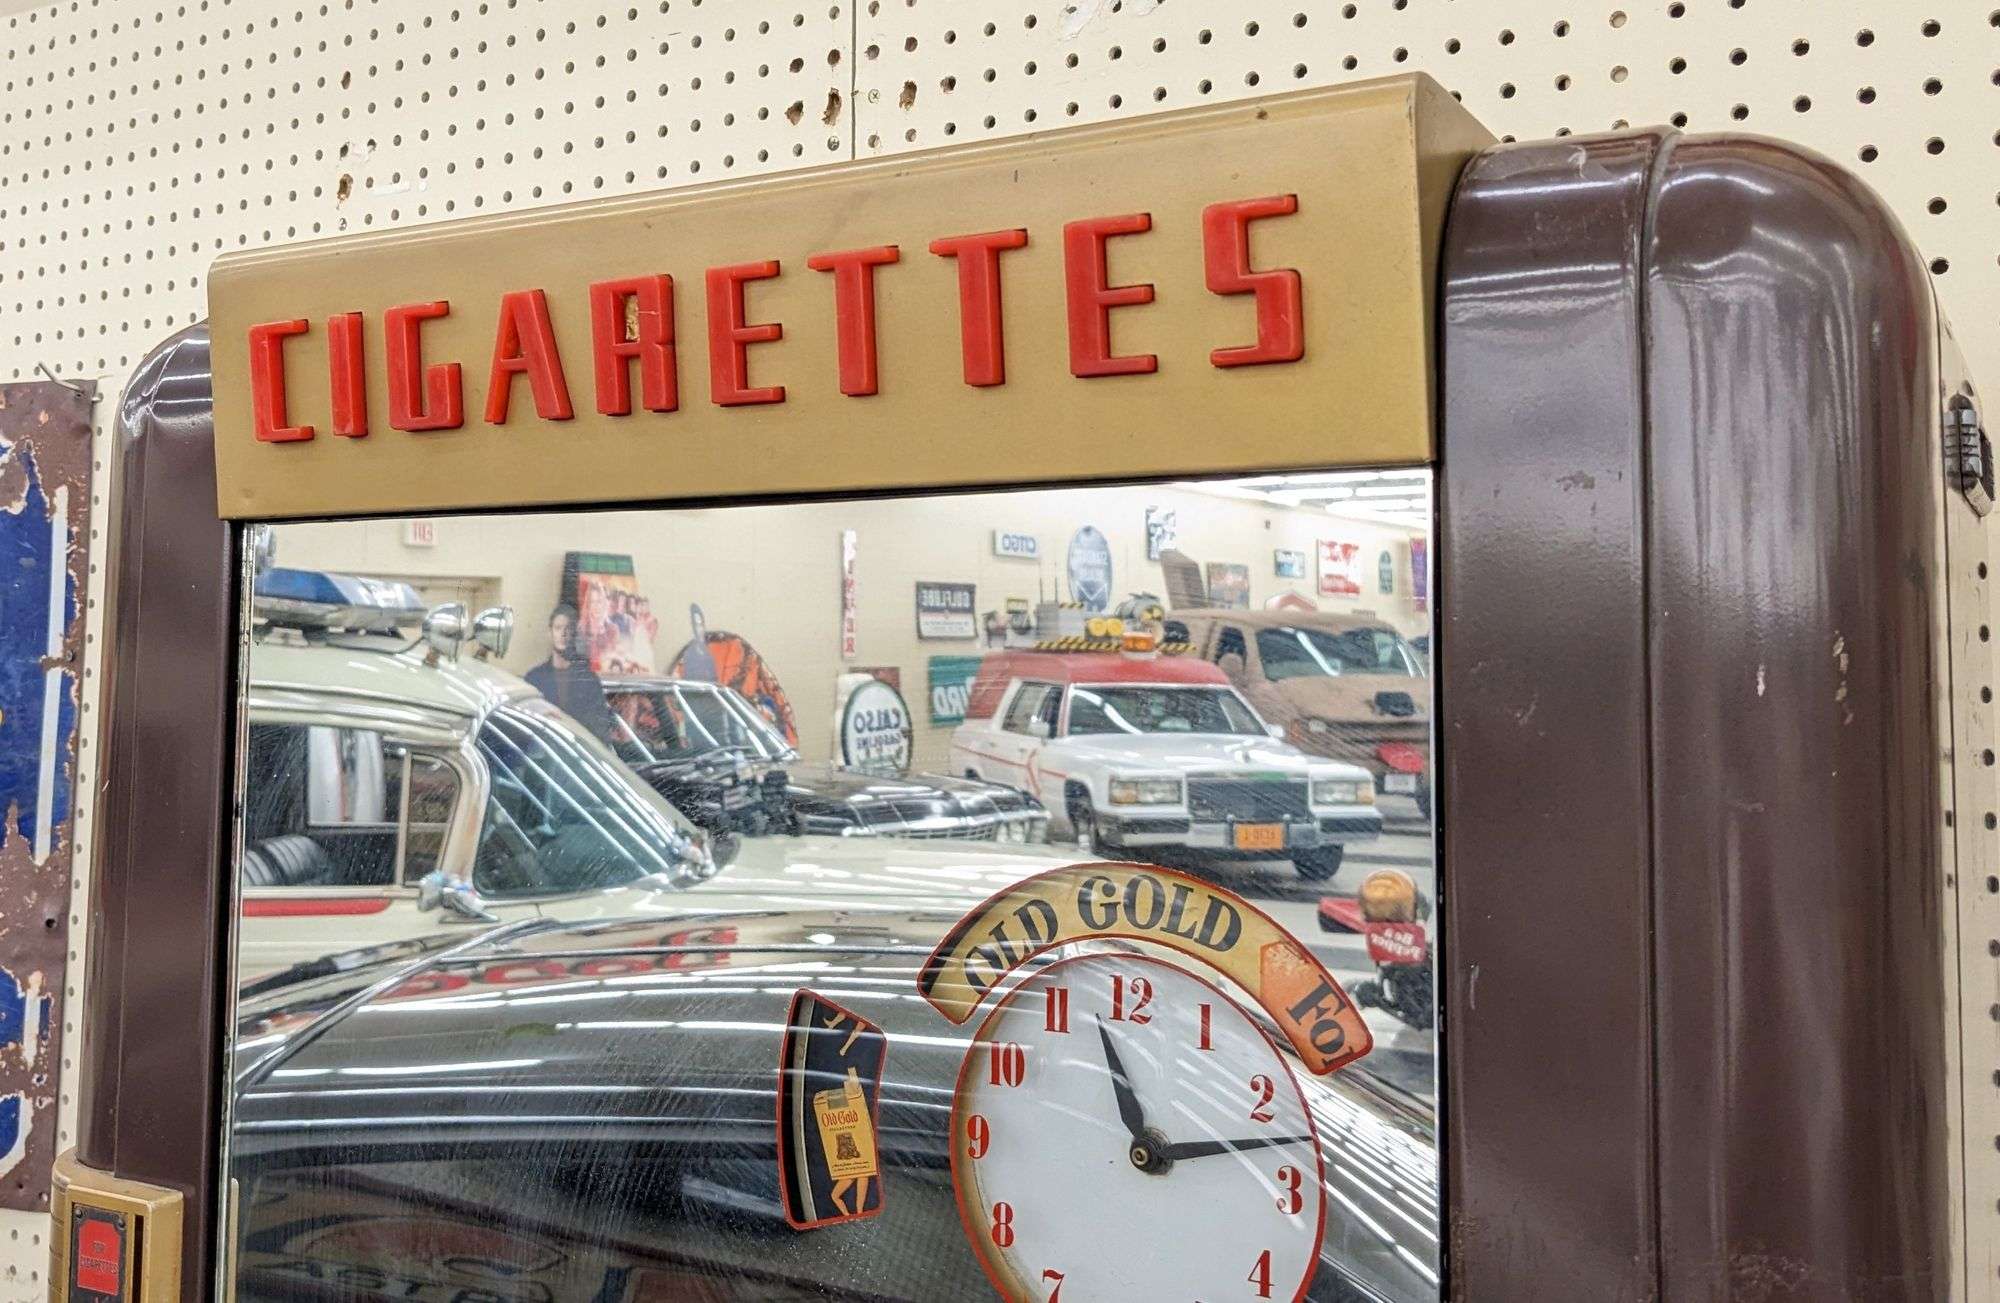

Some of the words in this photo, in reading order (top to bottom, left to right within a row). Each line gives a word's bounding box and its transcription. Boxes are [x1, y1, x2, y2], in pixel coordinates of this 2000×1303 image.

[248, 192, 1305, 444] CIGARETTES
[964, 899, 1059, 996] OLD
[1077, 874, 1243, 952] GOLD
[1044, 986, 1071, 1034] 11
[1108, 974, 1153, 1025] 12
[1197, 1002, 1215, 1052] 1
[988, 1040, 1025, 1088] 10
[821, 1111, 839, 1128] Old
[838, 1109, 859, 1125] Gold
[1250, 1074, 1275, 1123] 2
[967, 1114, 990, 1160] 9
[1276, 1164, 1303, 1216] 3
[992, 1201, 1015, 1248] 8
[1042, 1268, 1065, 1303] 7
[1247, 1249, 1275, 1299] 4
